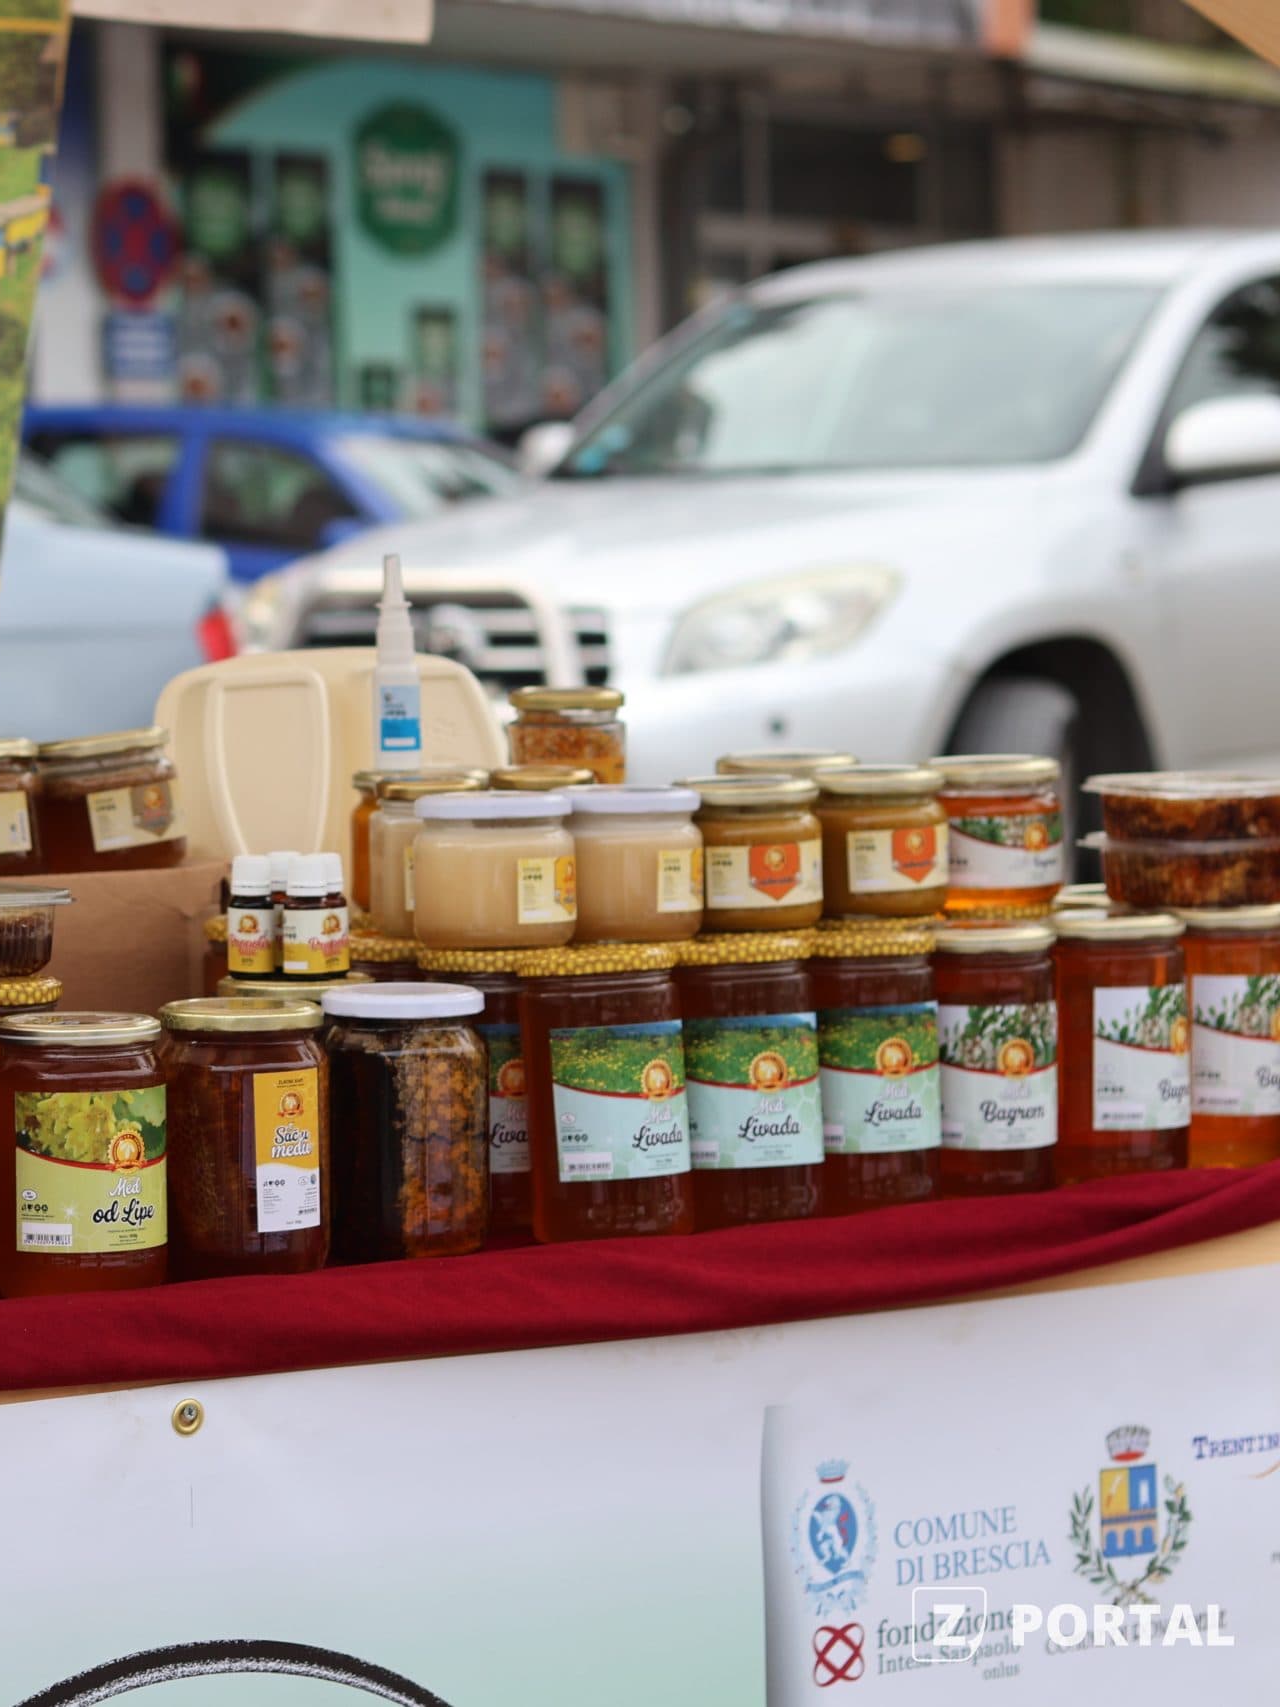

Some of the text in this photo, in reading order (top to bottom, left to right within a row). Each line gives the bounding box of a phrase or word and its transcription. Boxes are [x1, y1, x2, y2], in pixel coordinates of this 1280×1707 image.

[755, 1097, 785, 1115] Med
[863, 1101, 923, 1126] Livada
[979, 1099, 1045, 1125] Bagrem
[632, 1123, 683, 1151] Livada
[738, 1114, 801, 1142] Livada
[109, 1178, 141, 1197] Med
[93, 1198, 154, 1226] od Lipe
[893, 1506, 1018, 1549] COMUNE
[896, 1540, 1052, 1587] DI BRESCIA
[878, 1650, 933, 1675] Intesa
[982, 1661, 1021, 1681] onlus
